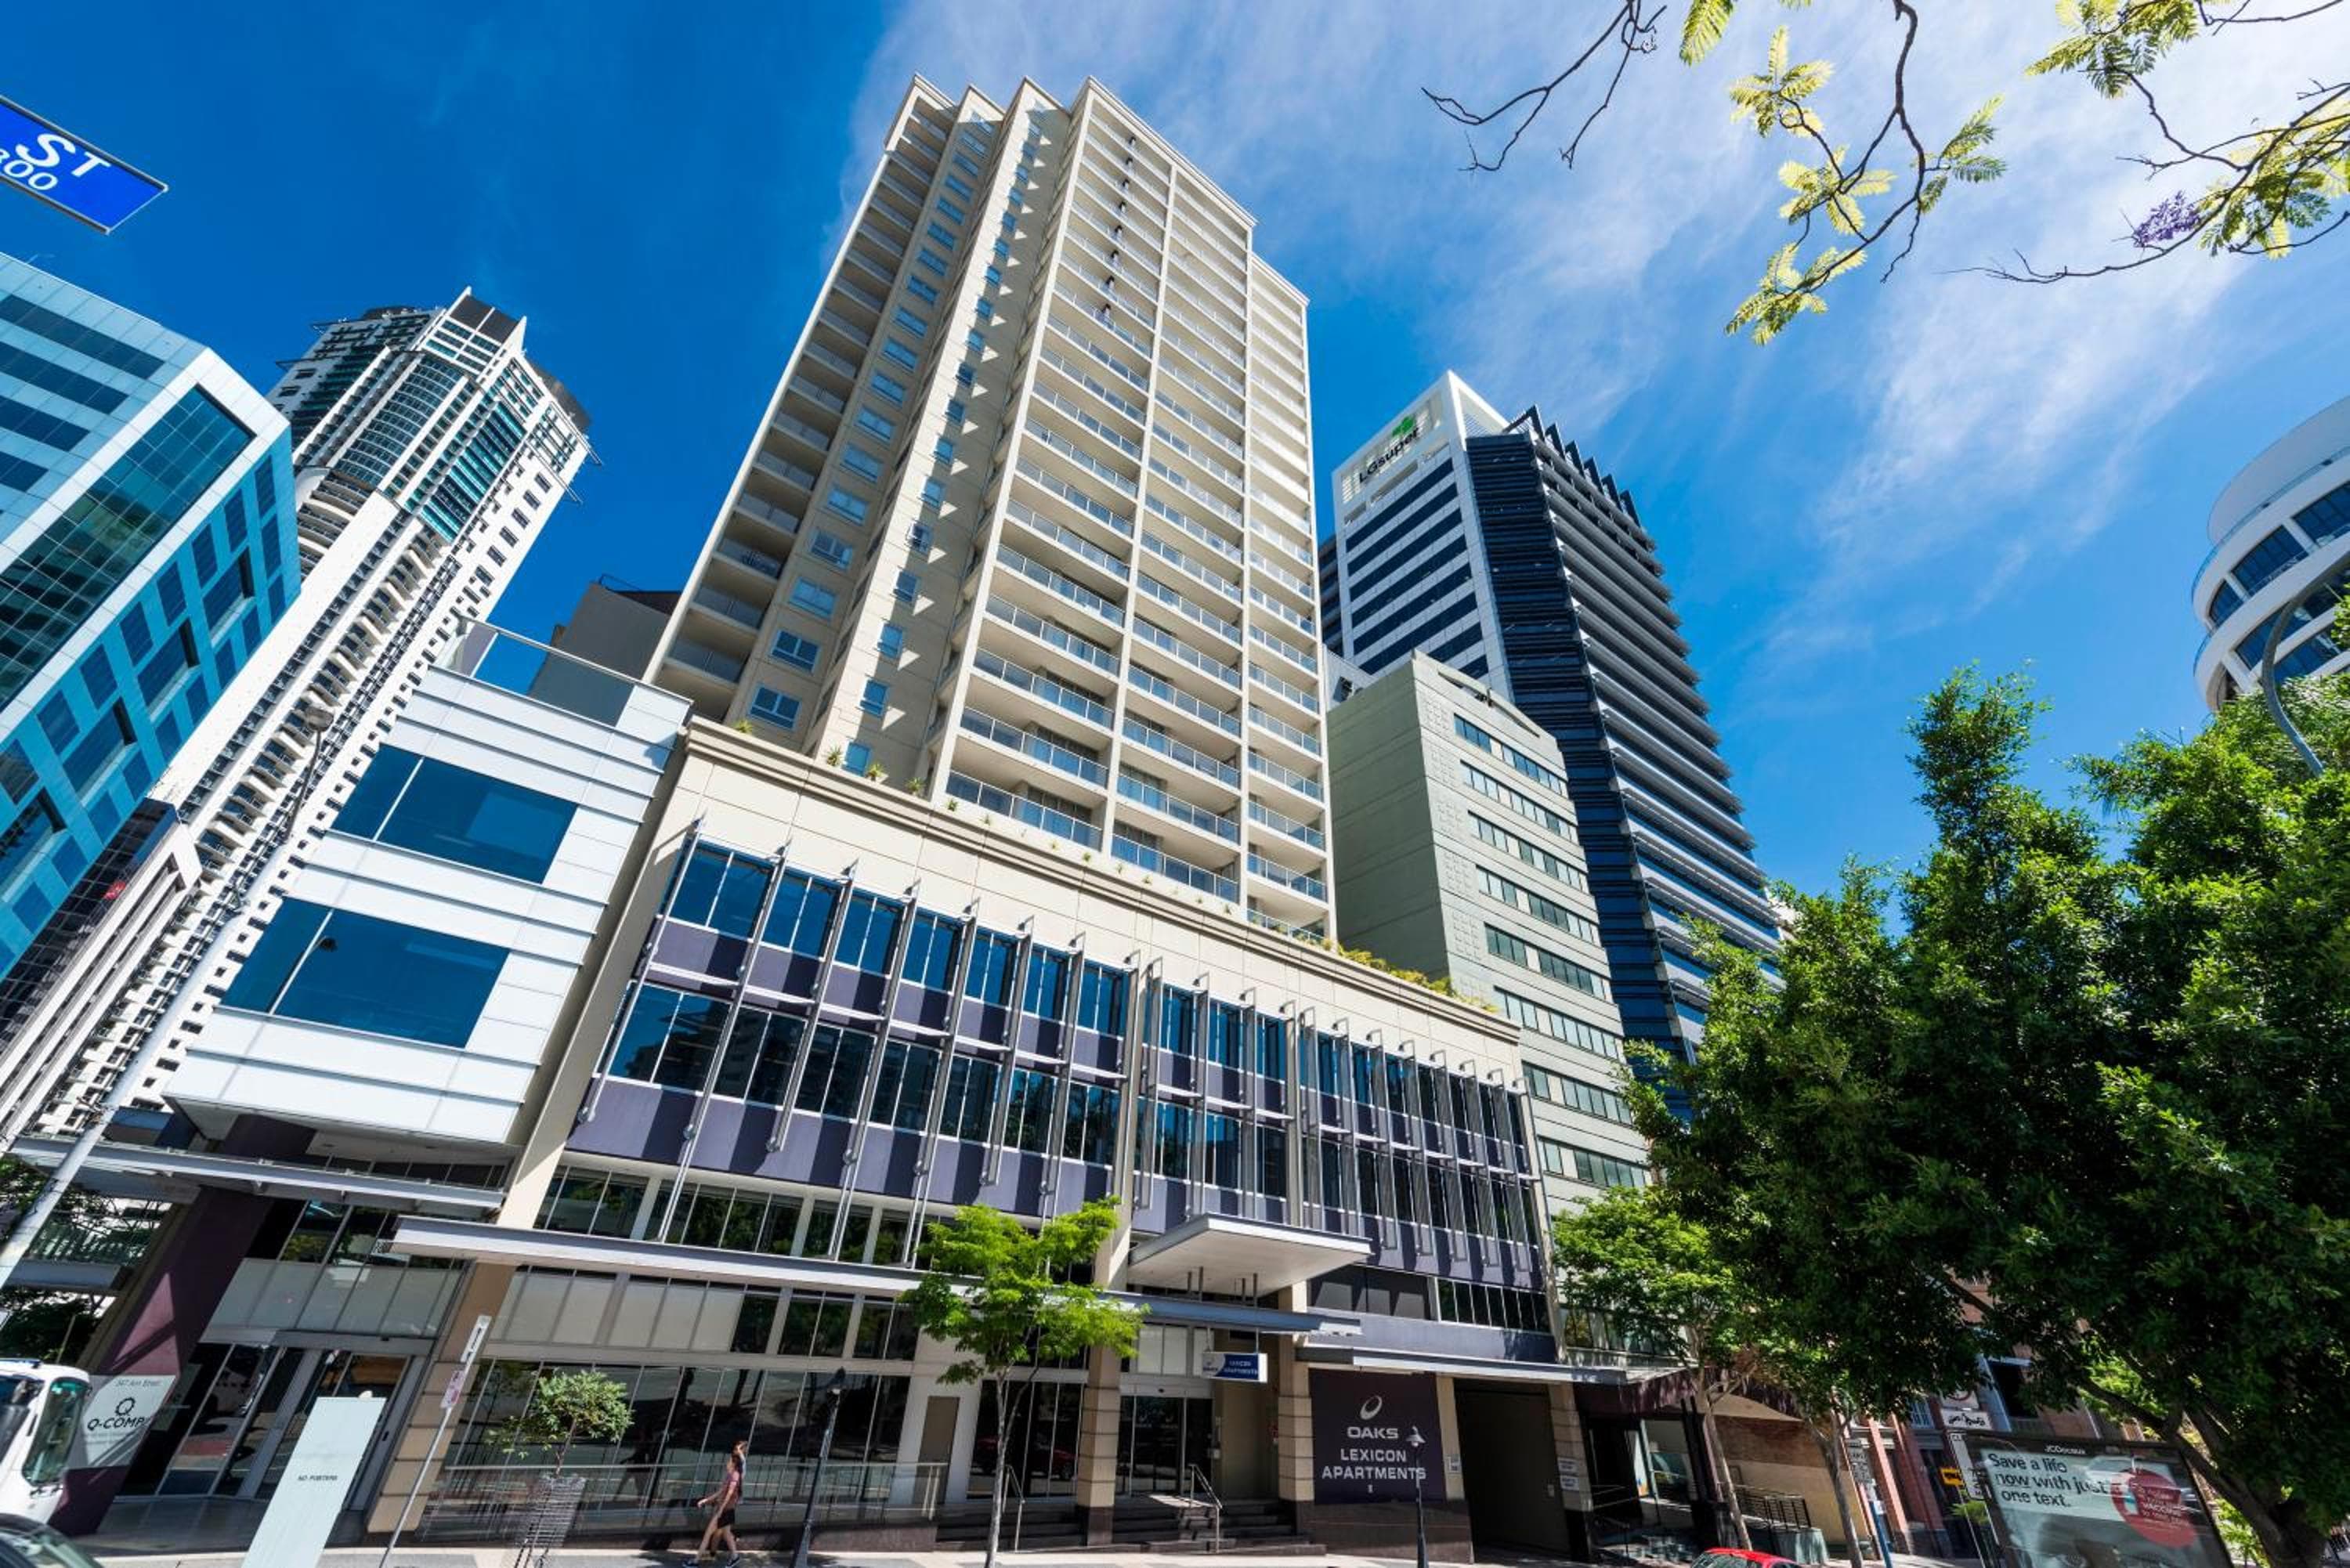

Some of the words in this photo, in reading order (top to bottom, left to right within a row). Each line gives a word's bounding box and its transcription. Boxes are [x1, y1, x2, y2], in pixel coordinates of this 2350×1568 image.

[15, 133, 111, 178] ST
[1359, 427, 1420, 483] LGsuper
[1347, 1426, 1400, 1440] OAKS
[1340, 1448, 1407, 1462] LEXICON
[1988, 1453, 2026, 1470] Save
[2030, 1460, 2041, 1471] a
[2042, 1458, 2068, 1473] life
[1321, 1465, 1426, 1479] APARTMENTS
[1996, 1473, 2030, 1486] now
[2032, 1476, 2072, 1490] with
[2073, 1477, 2109, 1494] just
[2001, 1490, 2031, 1503] one
[2033, 1492, 2072, 1508] text.
